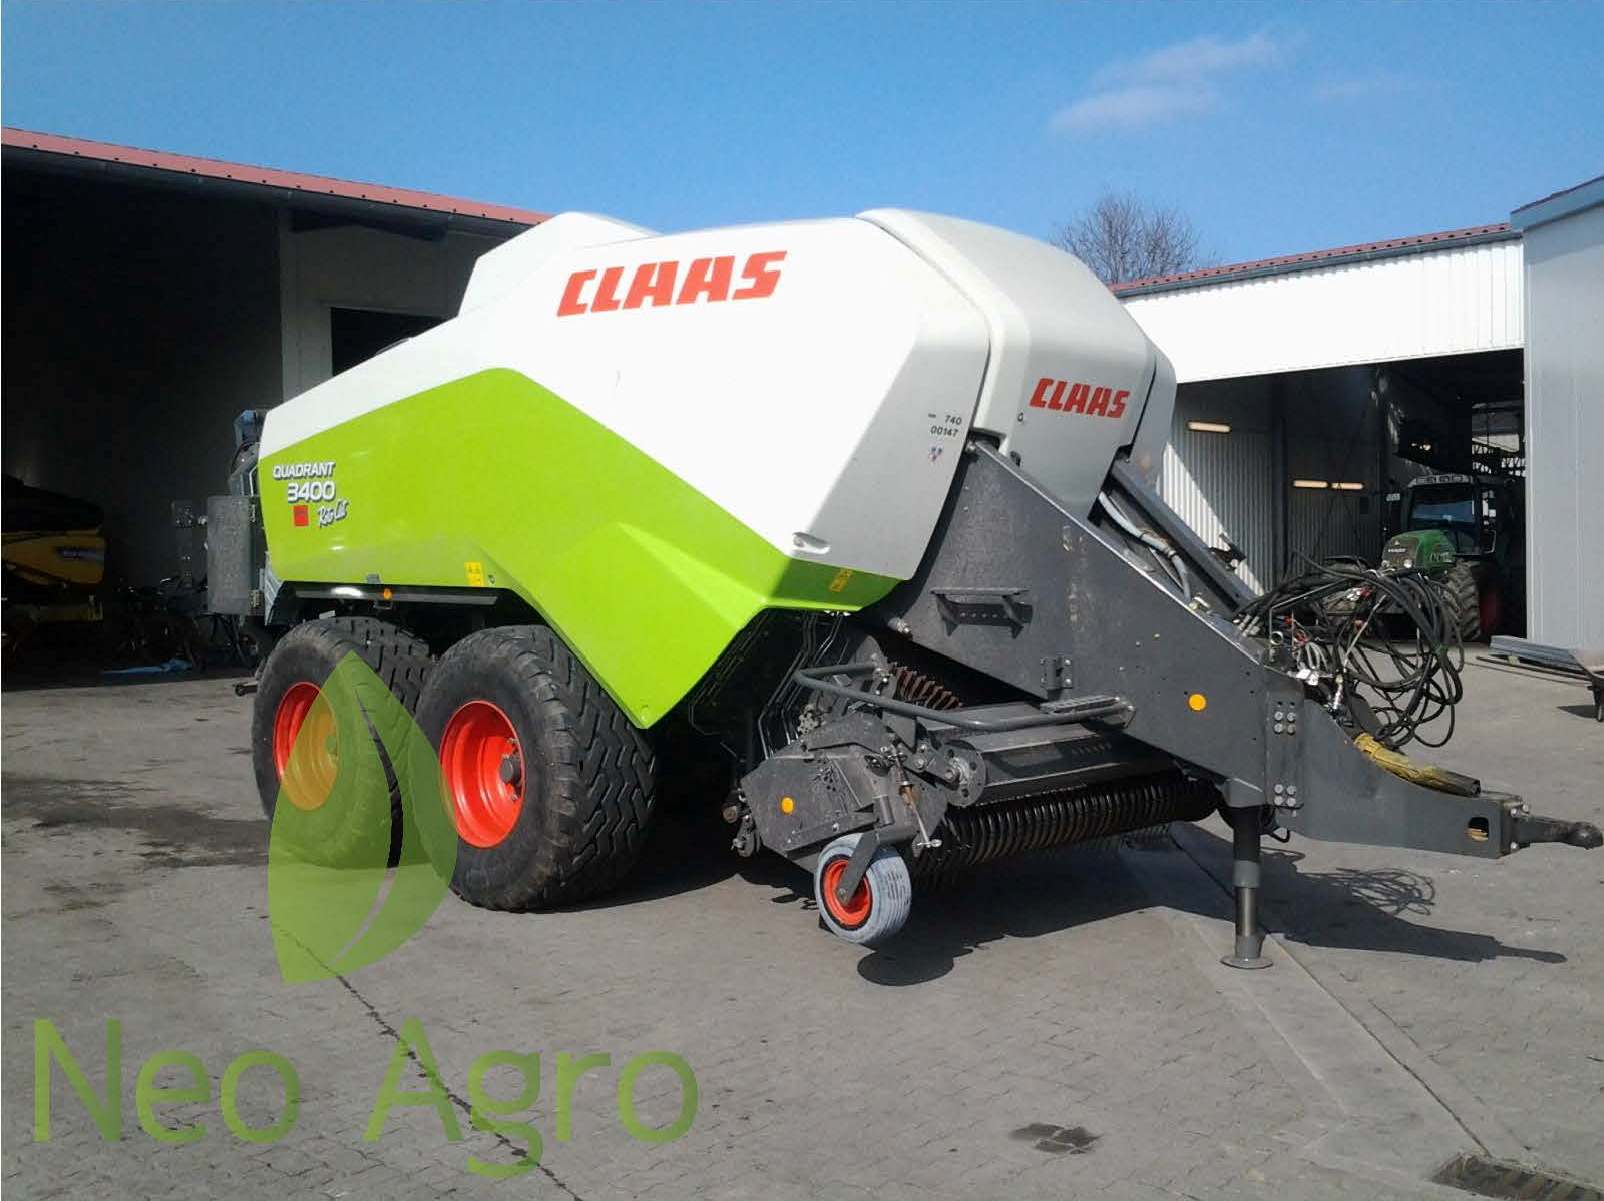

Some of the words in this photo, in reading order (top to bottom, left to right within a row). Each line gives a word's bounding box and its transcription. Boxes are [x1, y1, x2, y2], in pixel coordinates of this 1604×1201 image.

[557, 250, 788, 317] CLAAS
[1029, 377, 1131, 419] CLAAS
[273, 461, 336, 481] QUADRANT
[288, 480, 336, 504] 3400
